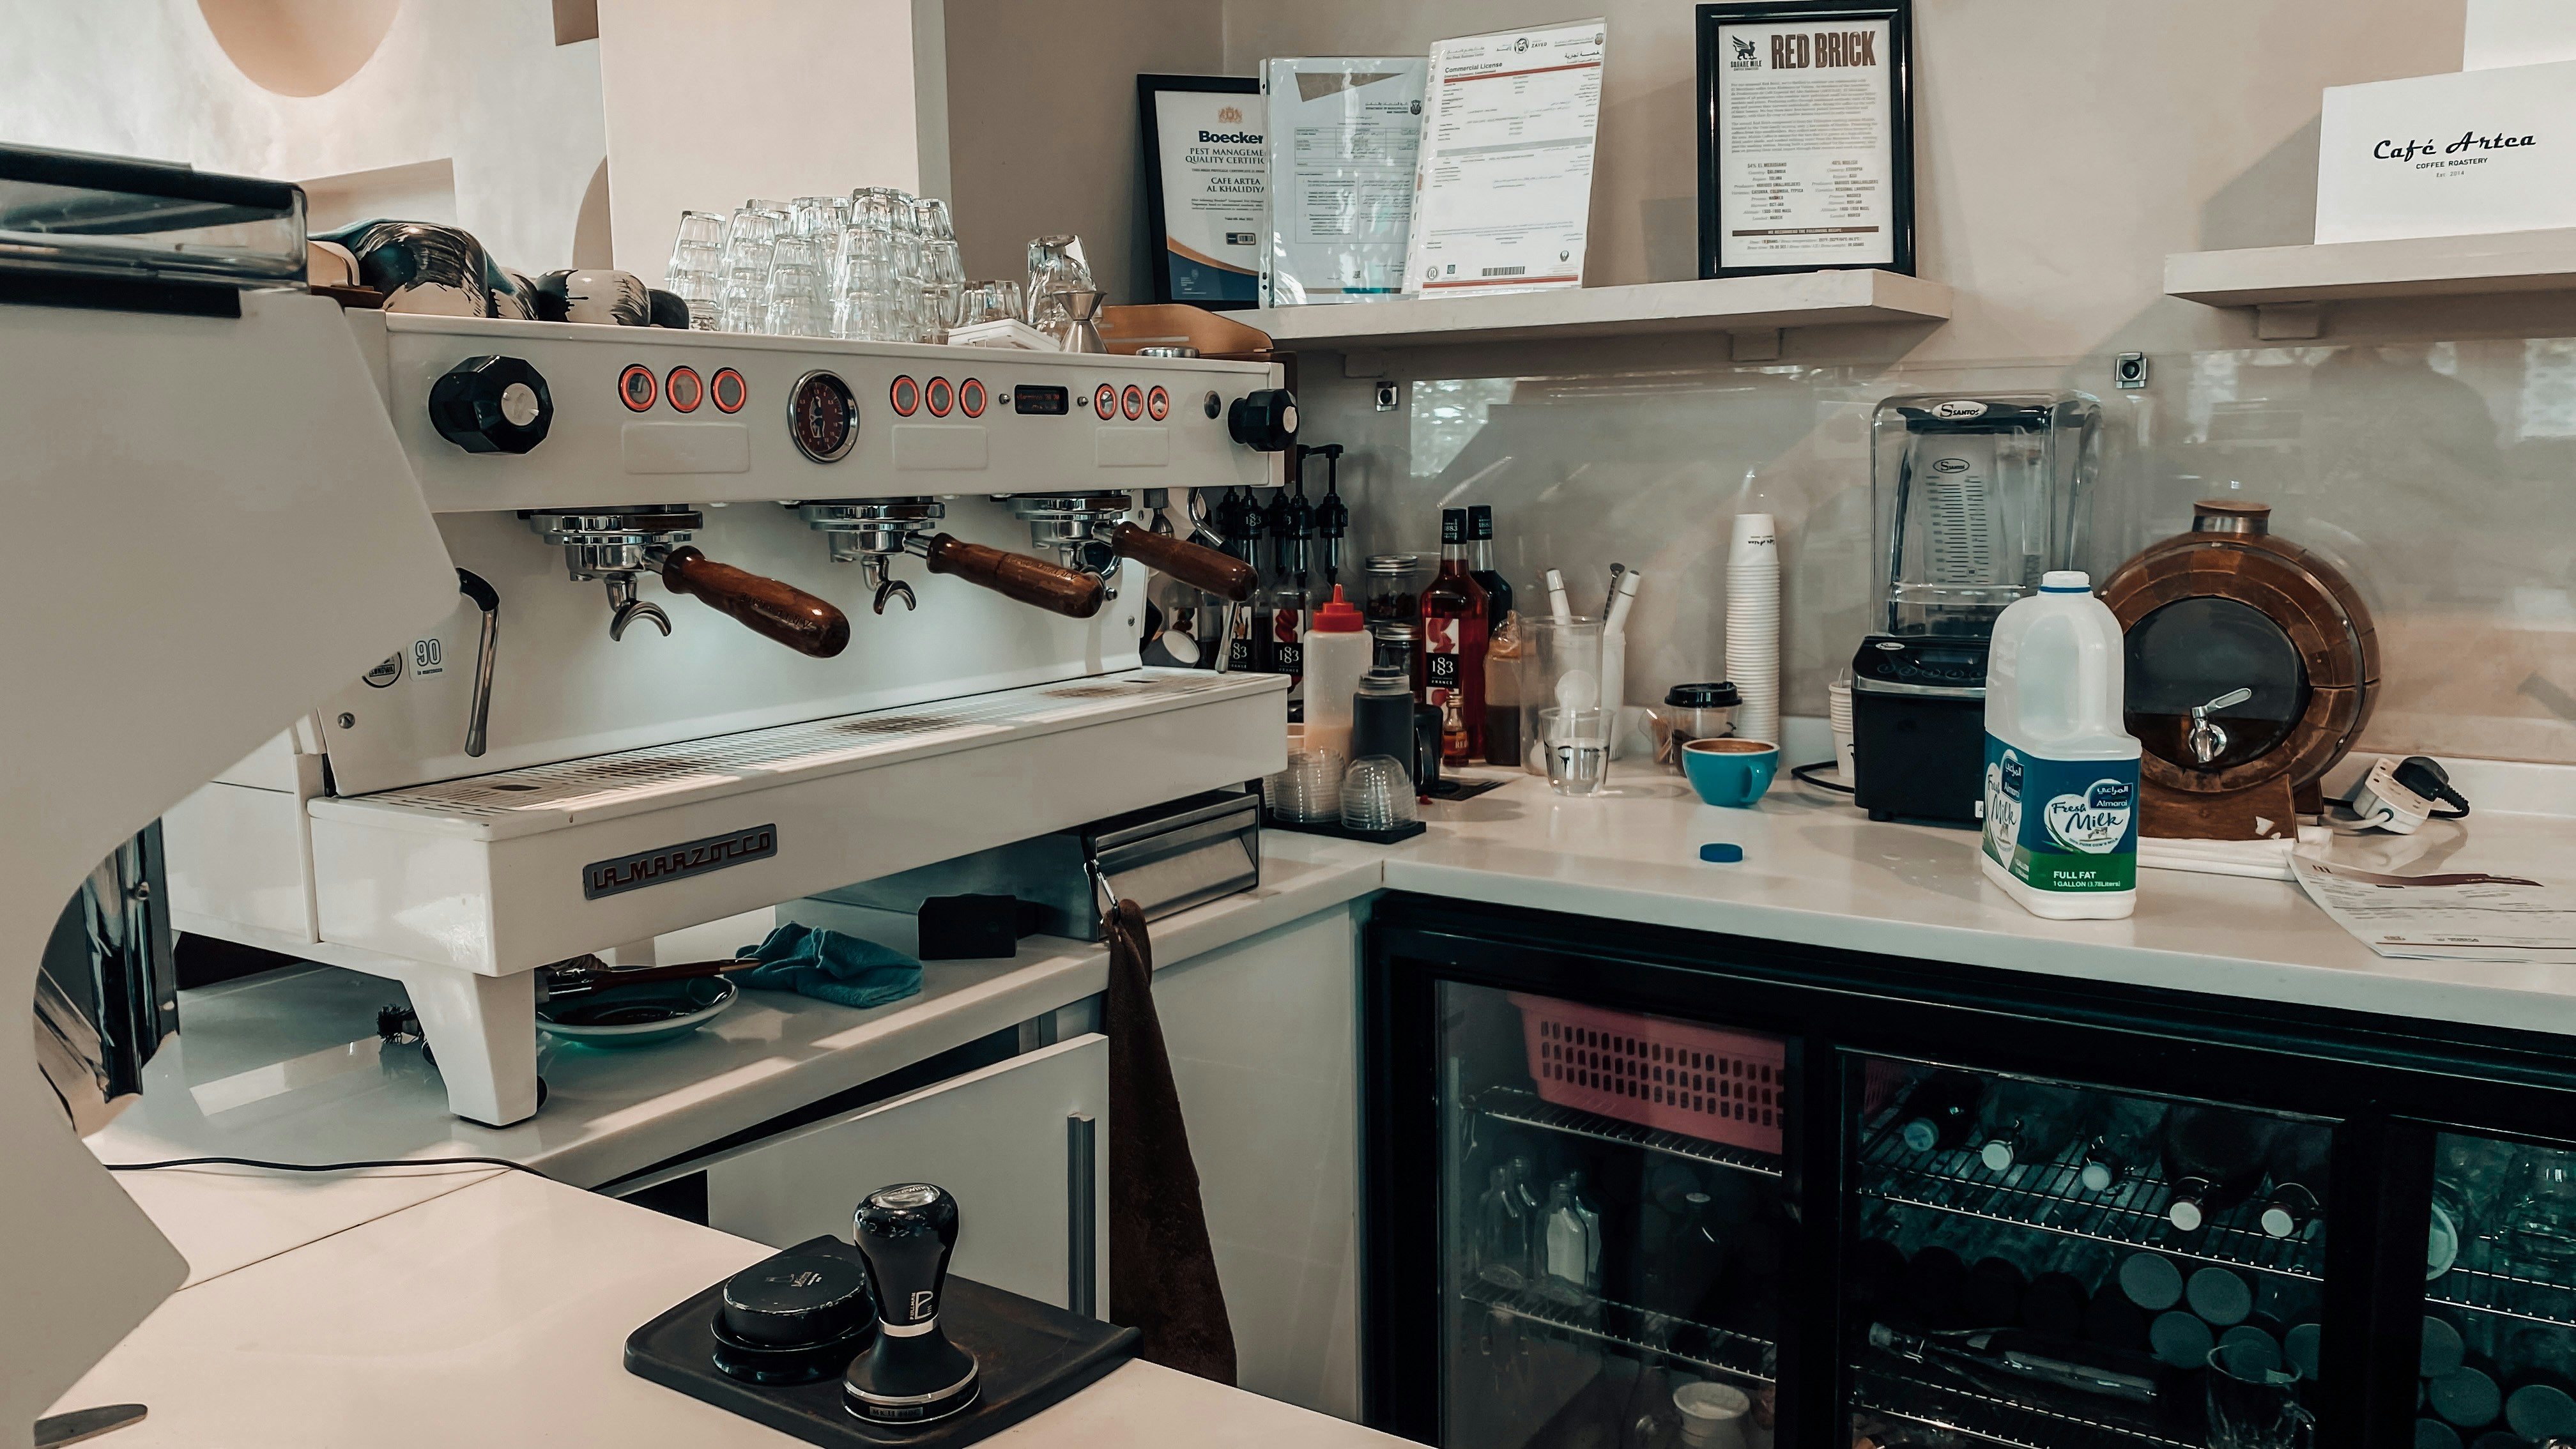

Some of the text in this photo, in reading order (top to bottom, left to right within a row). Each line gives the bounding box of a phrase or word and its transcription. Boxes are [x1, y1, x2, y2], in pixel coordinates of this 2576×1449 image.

[1771, 31, 1876, 70] RED BRICK
[1445, 64, 1479, 73] Commercial
[1198, 130, 1264, 144] Boecker
[1212, 148, 1266, 157] MANAGEME
[2373, 139, 2437, 162] Café
[1185, 155, 1224, 164] QUALITY
[2416, 157, 2488, 169] COFFEE ROASTERY
[415, 638, 442, 667] 90
[2096, 785, 2129, 795] المراعي
[1991, 793, 2018, 826] Milk
[2051, 801, 2087, 814] Fresh
[2064, 812, 2124, 834] Milk
[592, 831, 771, 891] LA MARZOCCO
[2053, 871, 2078, 879] FULL
